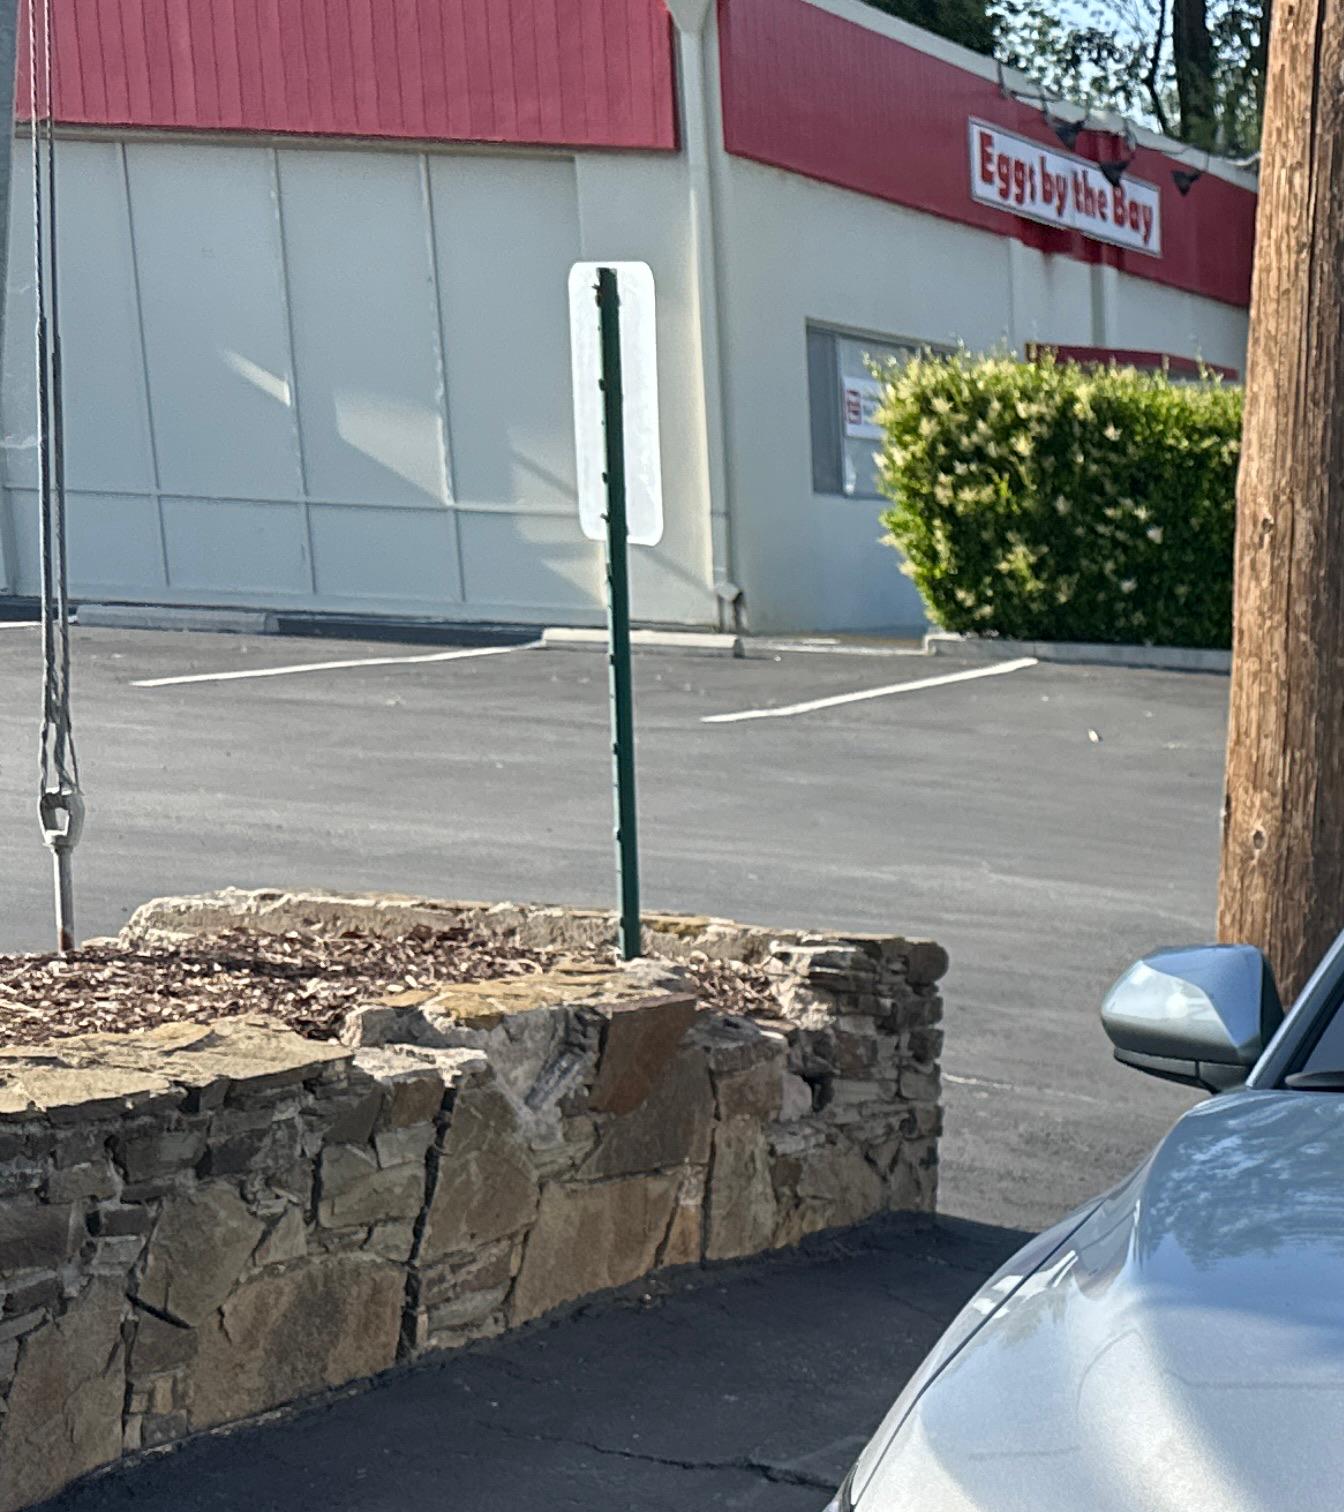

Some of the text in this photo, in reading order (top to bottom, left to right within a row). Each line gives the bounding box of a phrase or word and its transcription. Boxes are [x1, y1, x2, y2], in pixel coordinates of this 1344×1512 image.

[1040, 155, 1068, 217] by
[1072, 168, 1107, 222] the
[1112, 183, 1154, 245] Bay
